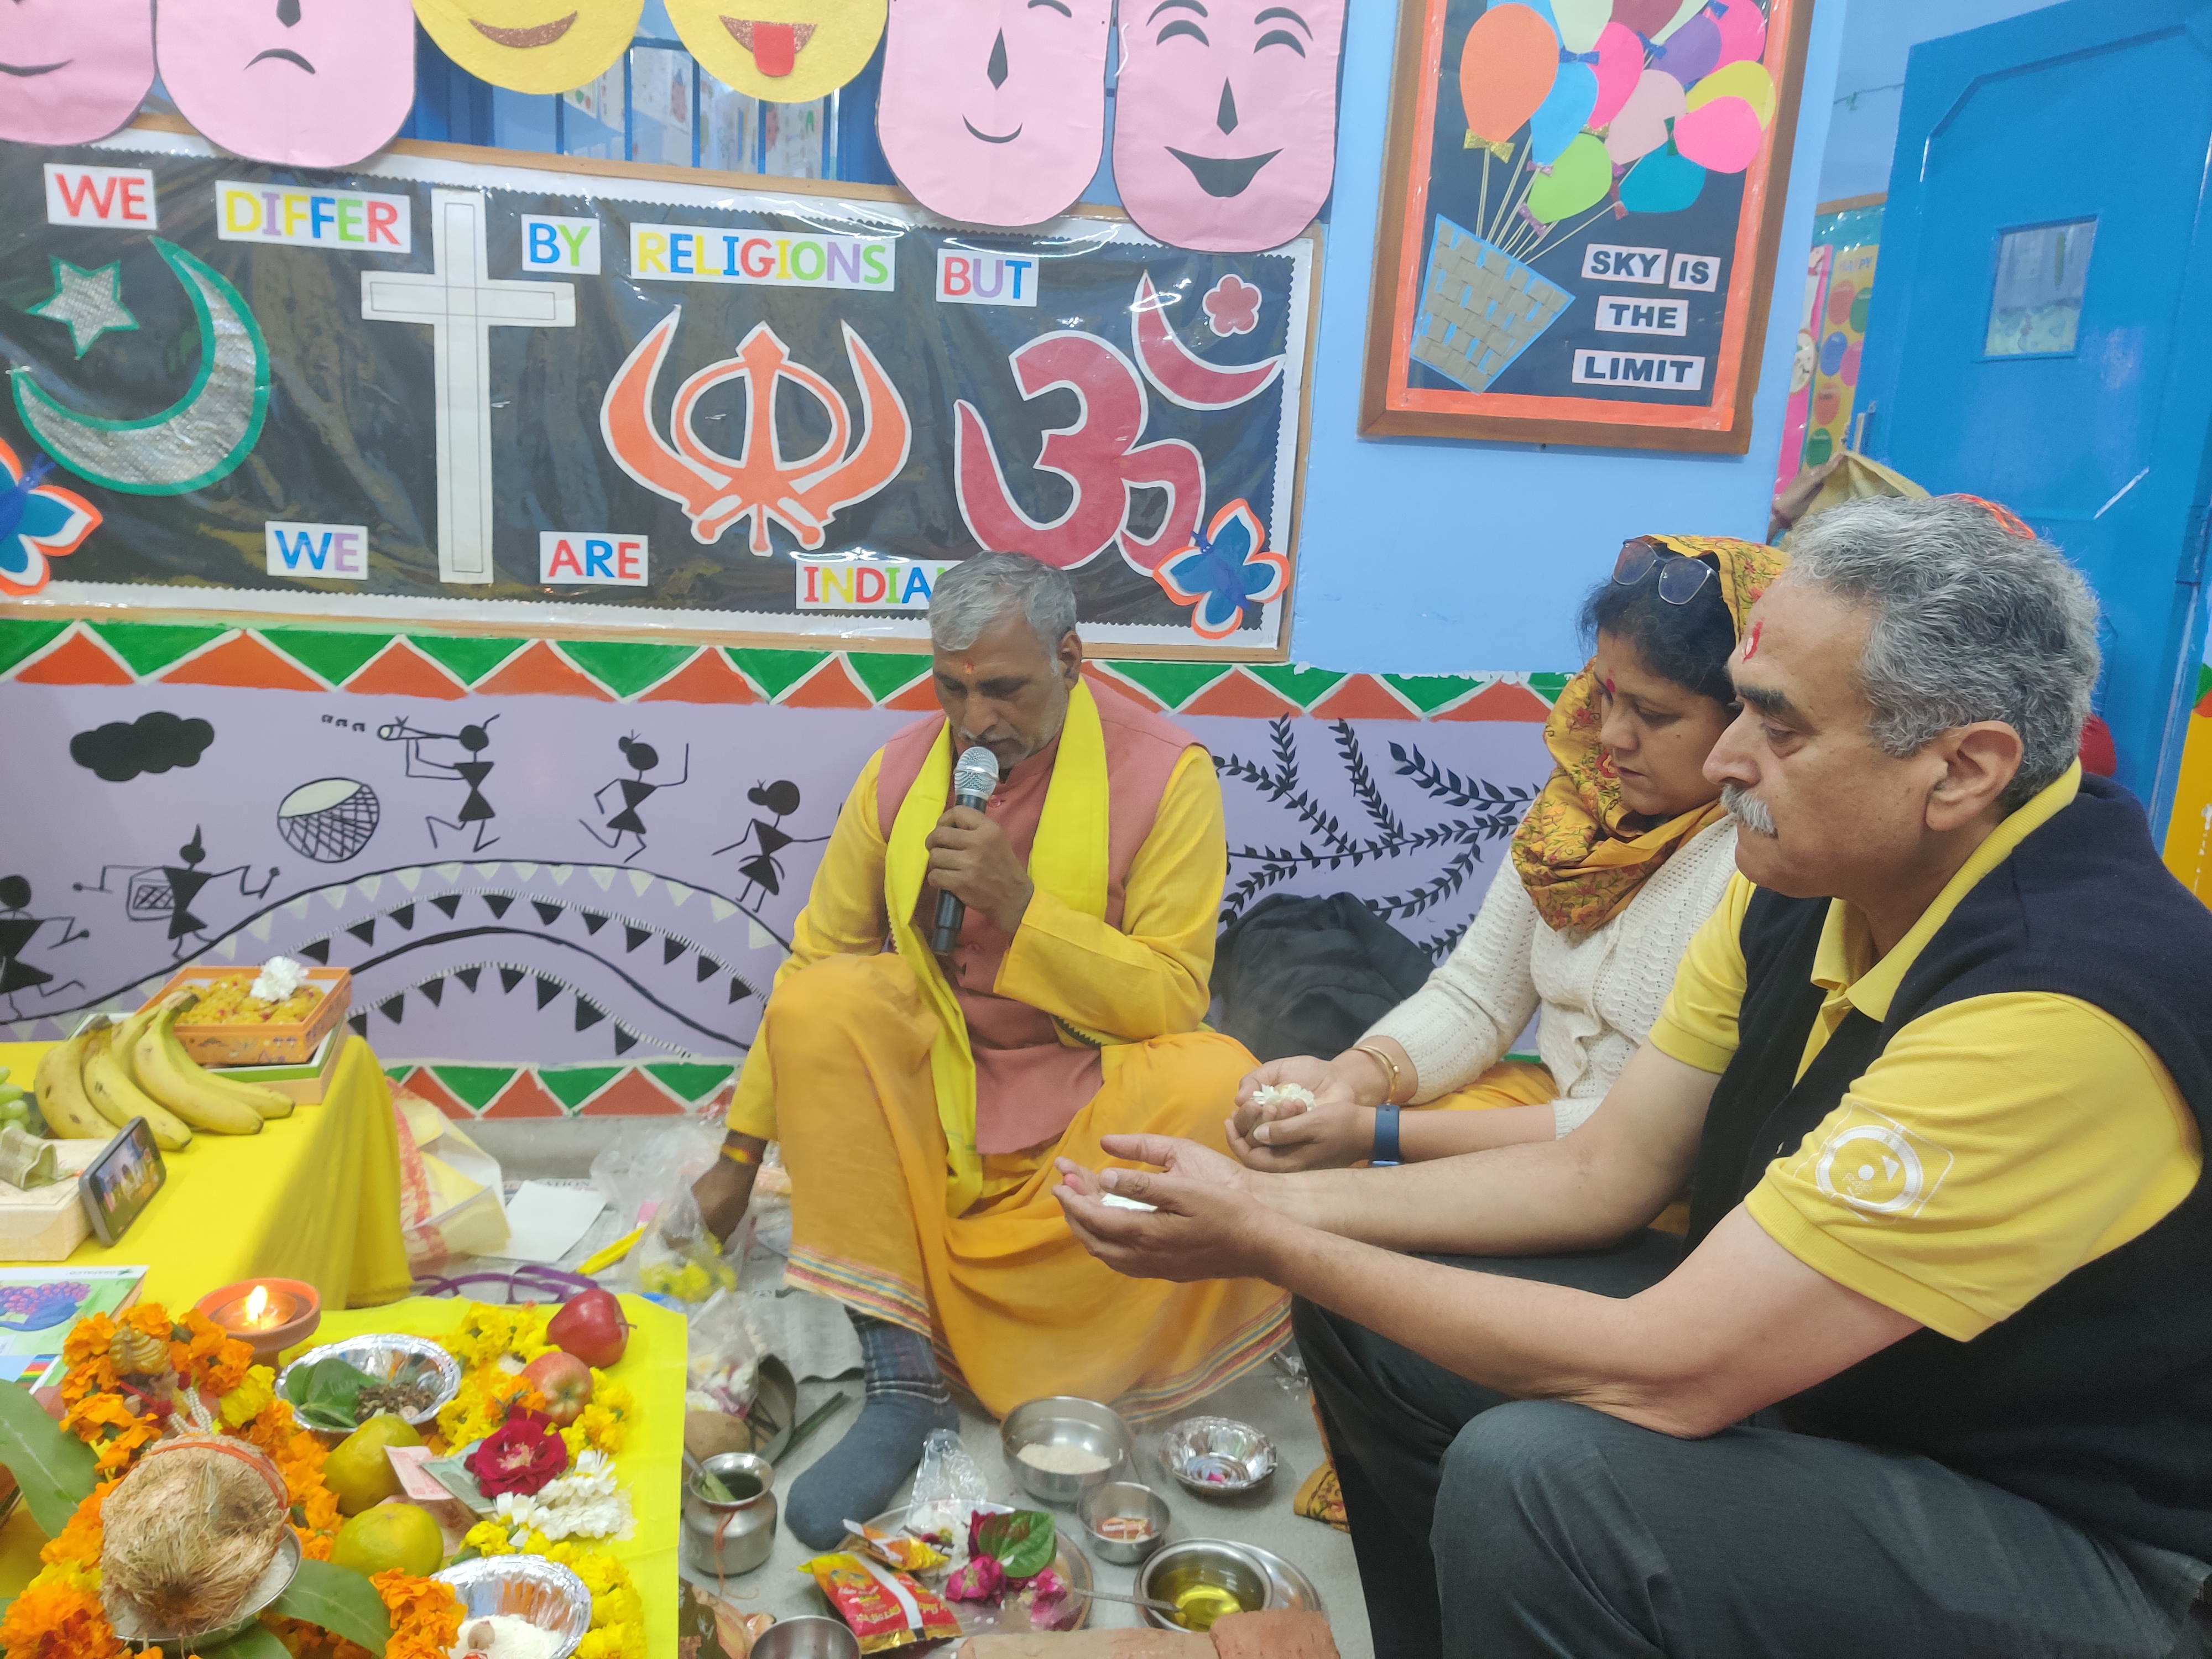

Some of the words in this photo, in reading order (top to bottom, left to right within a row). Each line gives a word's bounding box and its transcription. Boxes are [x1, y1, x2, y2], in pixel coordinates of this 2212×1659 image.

[54, 173, 148, 221] WE
[225, 190, 403, 246] DIFFER
[528, 222, 591, 267] BY
[638, 232, 889, 285] RELIGIONS
[943, 256, 1032, 300] BUT
[1590, 251, 1661, 278] SKY
[1679, 260, 1710, 284] IS
[1608, 304, 1678, 328] THE
[1584, 356, 1693, 383] LIMIT
[274, 529, 359, 572] WE
[547, 539, 641, 580] ARE
[803, 566, 946, 604] INDIA
